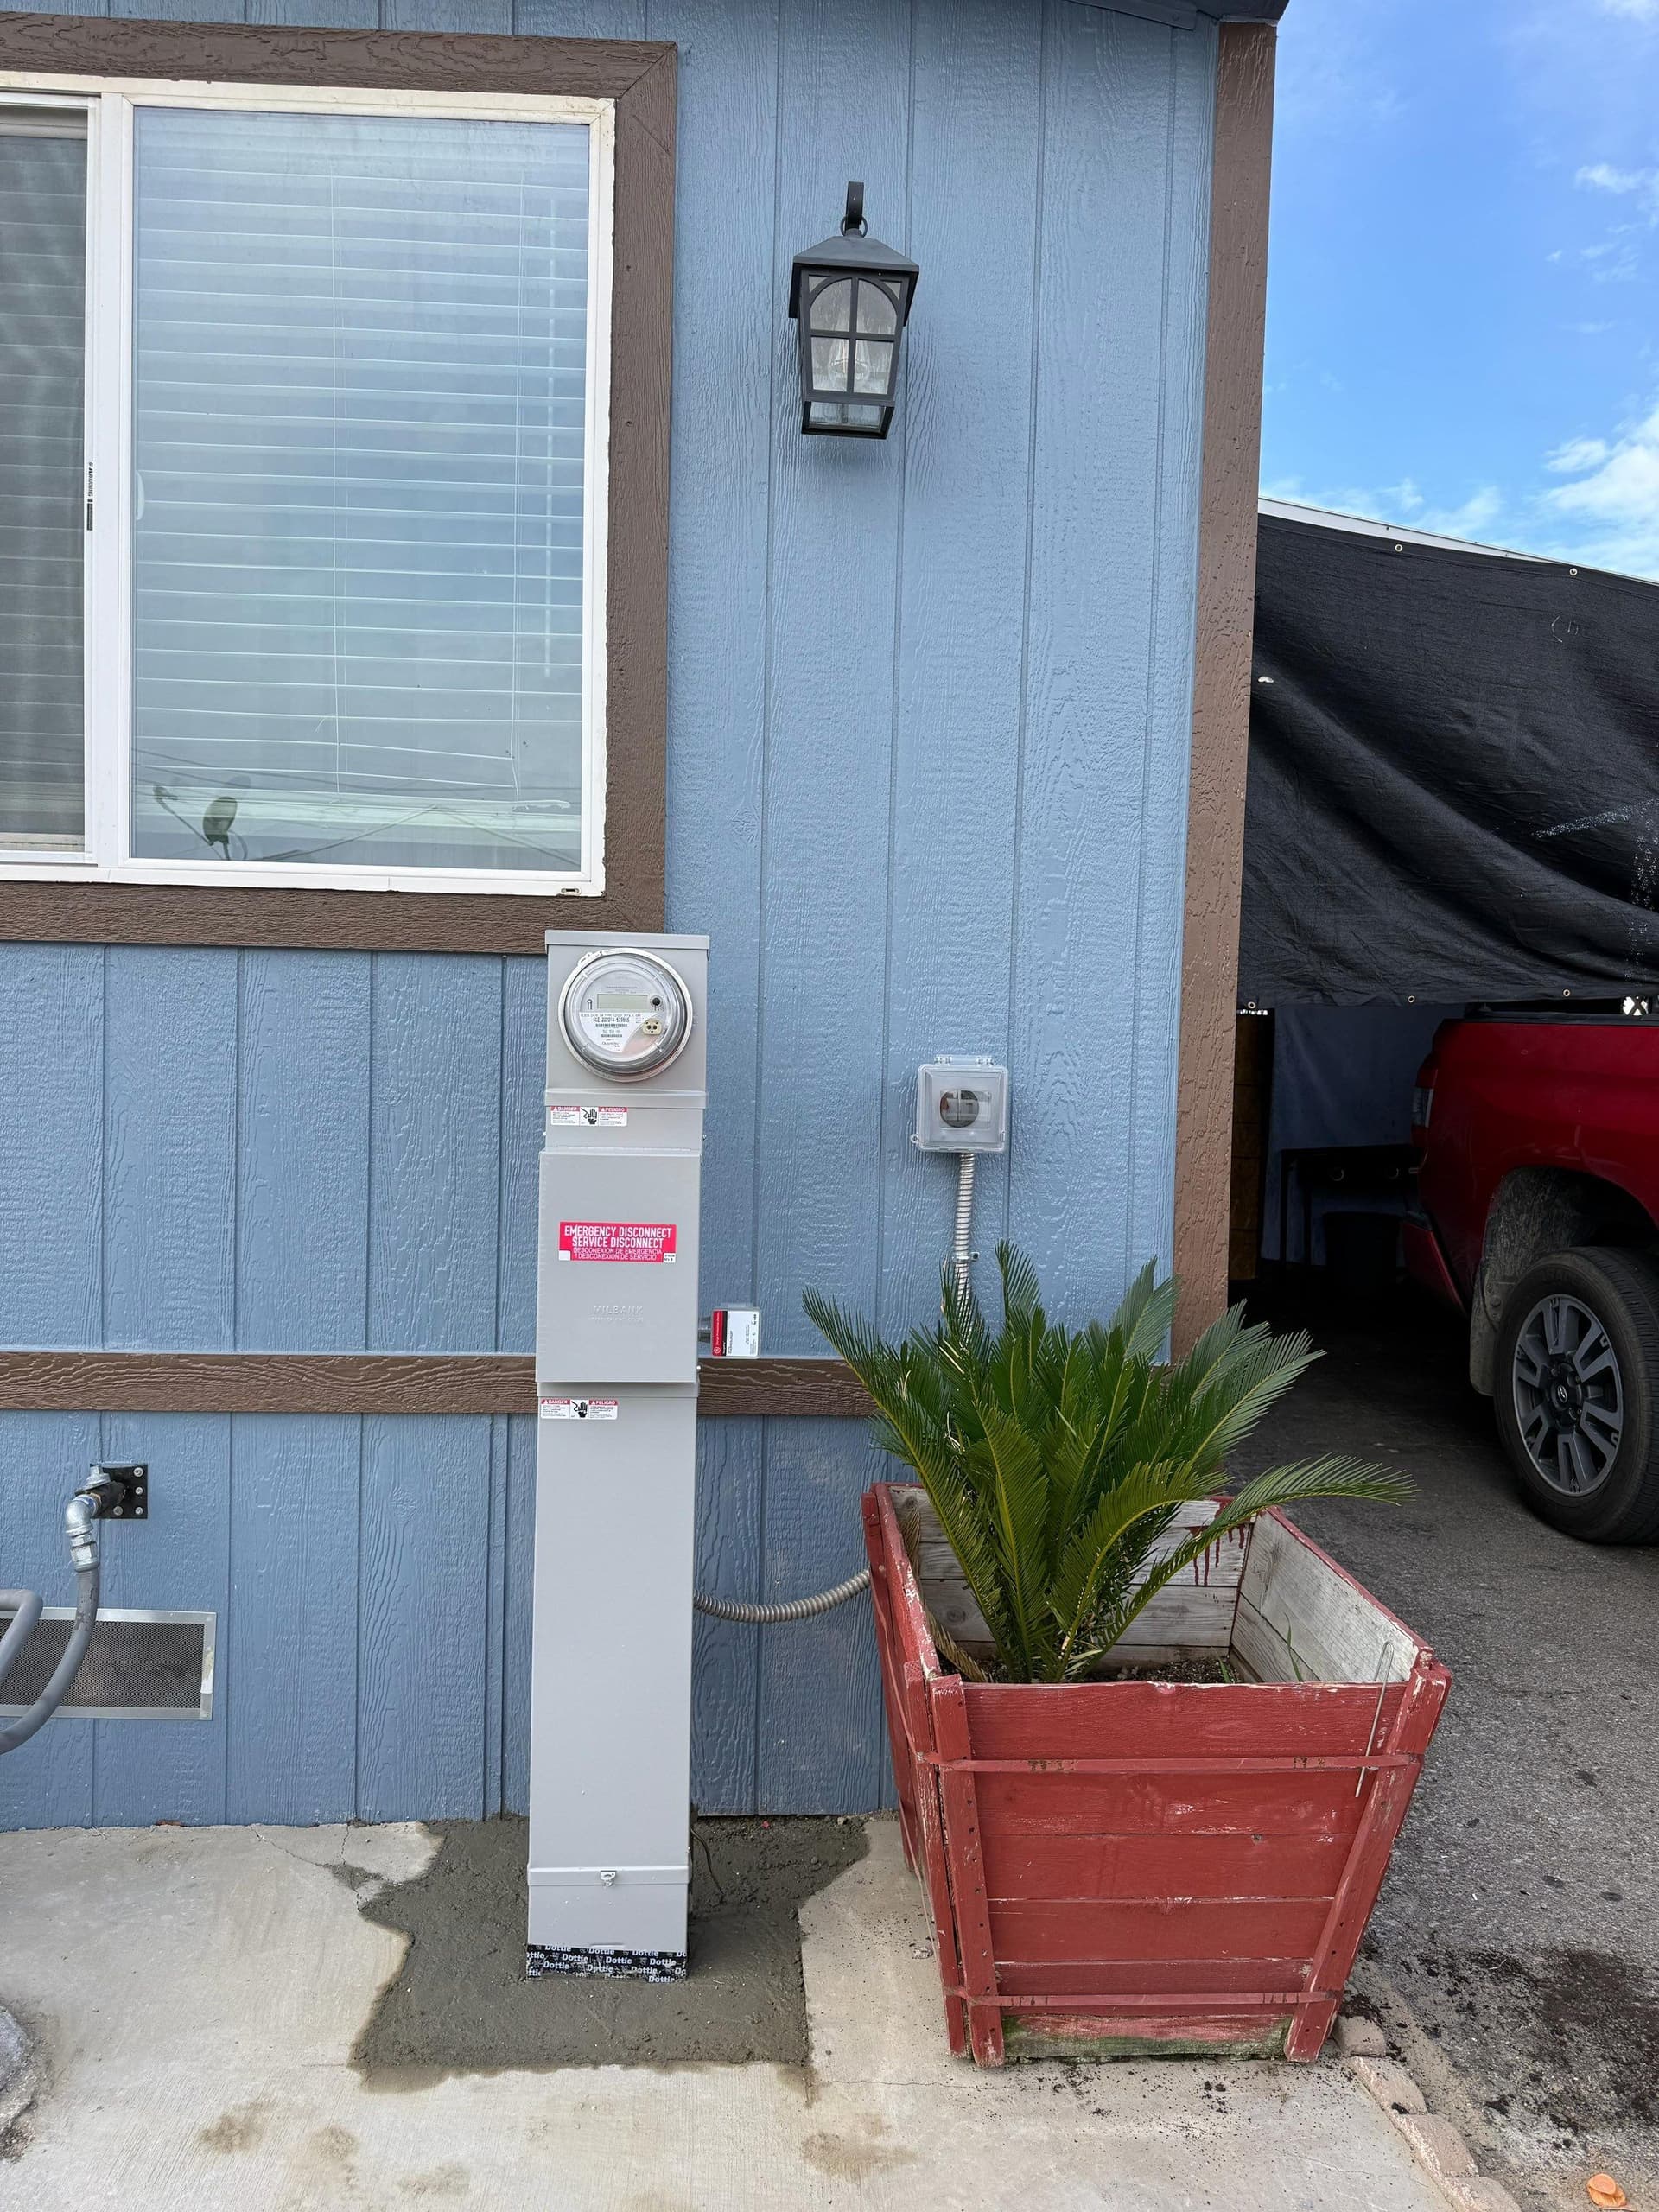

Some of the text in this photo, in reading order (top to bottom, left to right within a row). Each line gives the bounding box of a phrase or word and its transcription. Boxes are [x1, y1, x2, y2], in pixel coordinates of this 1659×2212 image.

[564, 1225, 672, 1238] EMERGENCY DISCONNECT
[572, 1236, 664, 1249] SERVICE DISCONNECT
[593, 1306, 644, 1314] MILBANK
[562, 1954, 588, 1962] Dottie
[543, 1961, 658, 1974] Dottie Dottie Dottie
